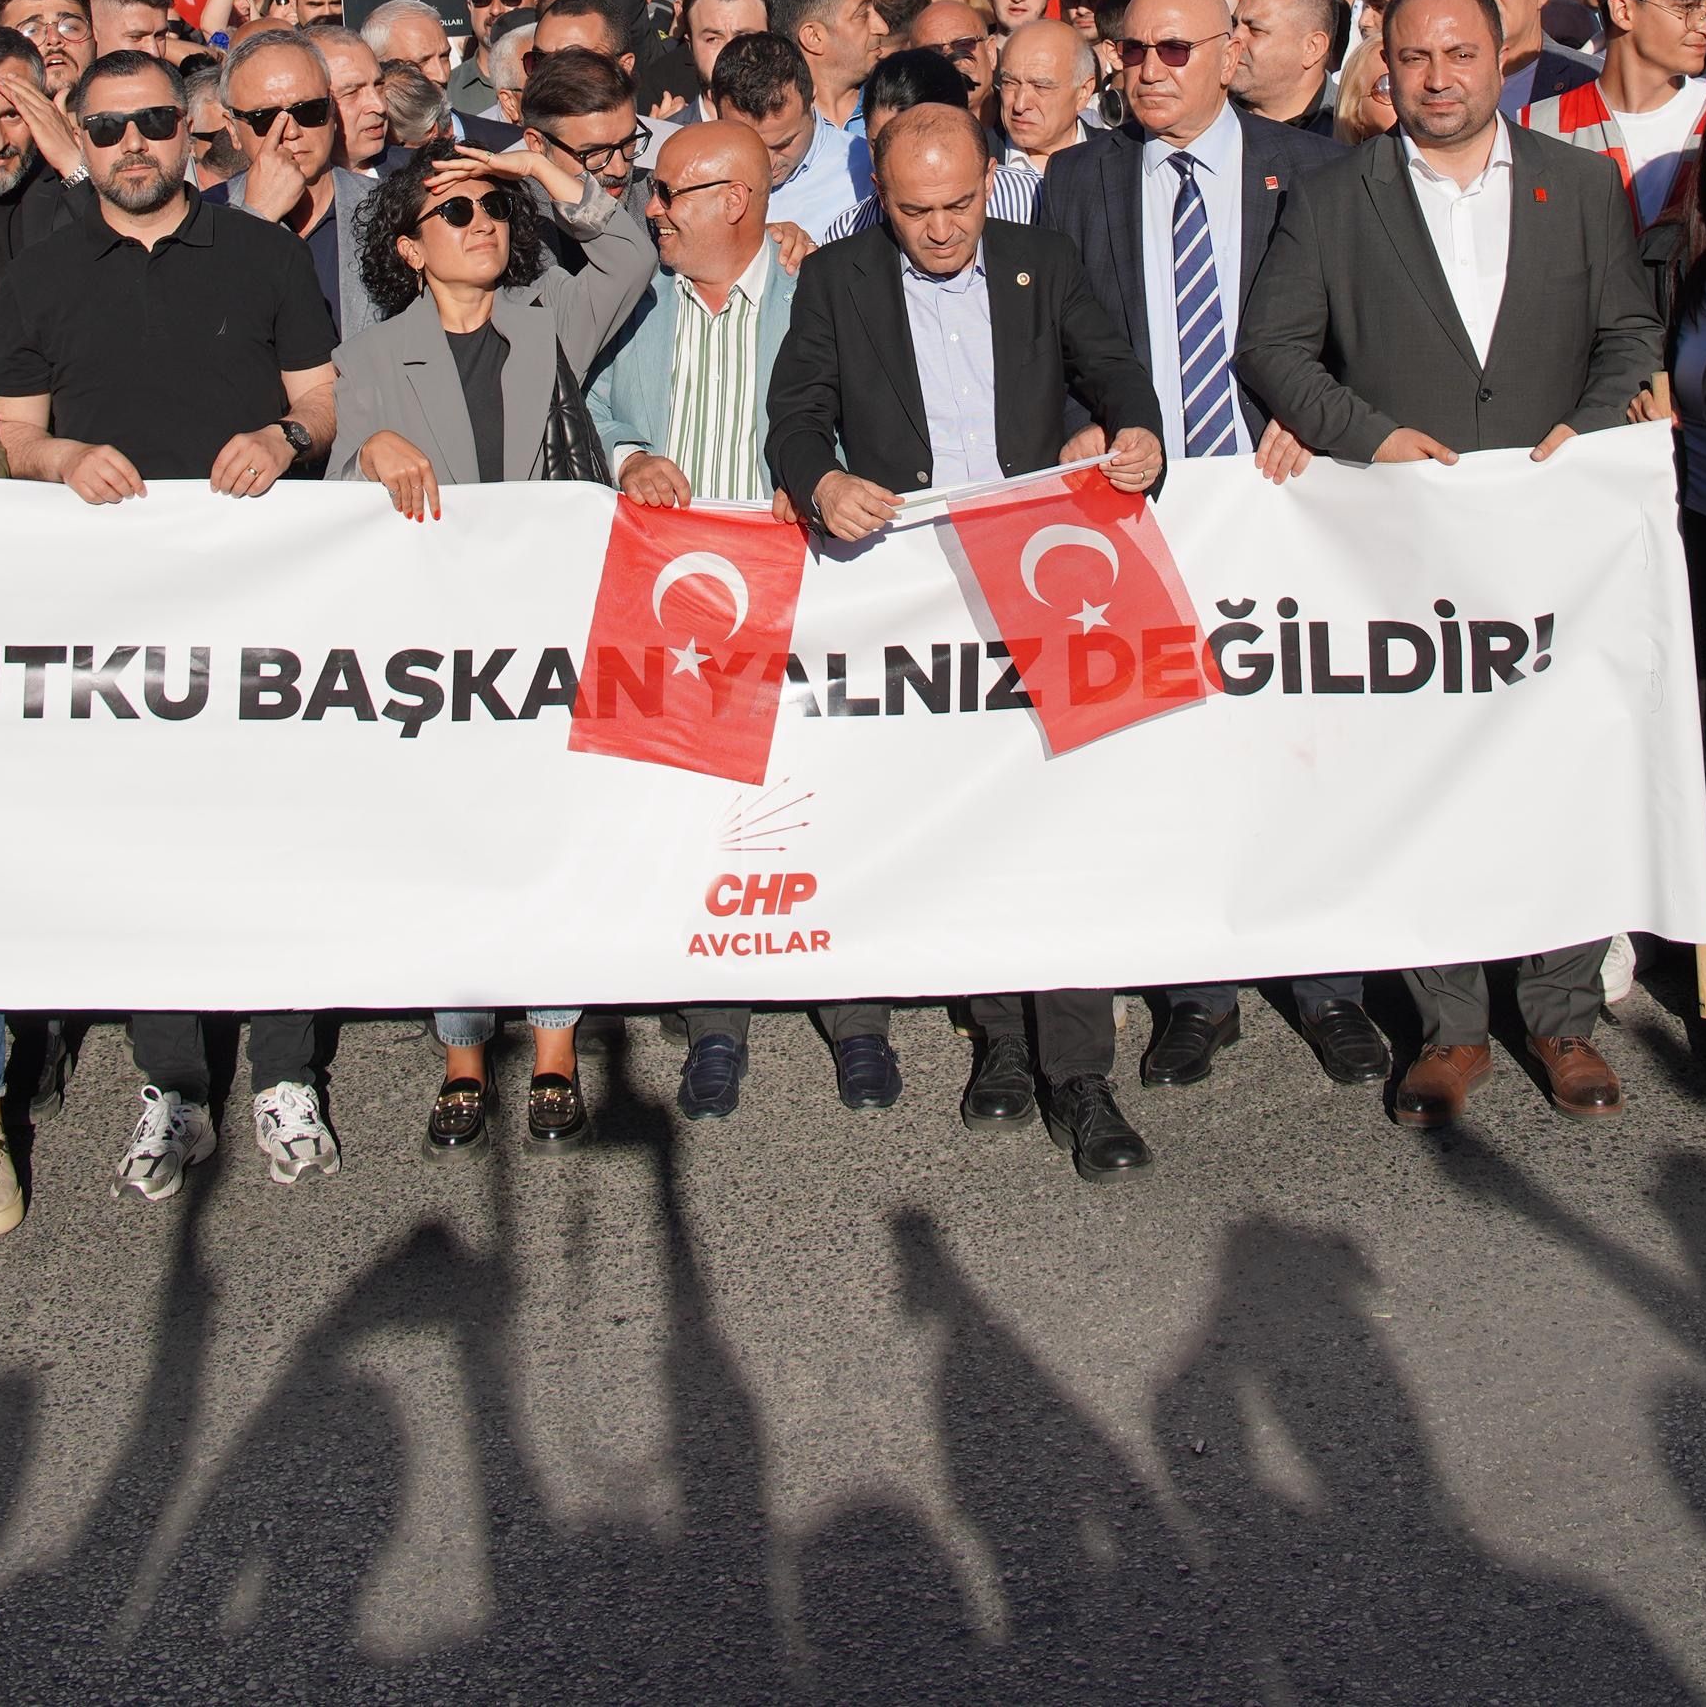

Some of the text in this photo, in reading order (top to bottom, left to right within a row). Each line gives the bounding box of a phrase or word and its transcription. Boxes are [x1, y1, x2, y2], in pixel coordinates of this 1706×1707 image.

[440, 18, 463, 27] OLLARI
[238, 647, 667, 739] BAŞKAN
[700, 637, 1044, 721] YALNIZ
[1067, 596, 1555, 707] DEĞİLDİR!
[705, 872, 818, 917] CHP
[687, 930, 831, 957] AVCILAR
